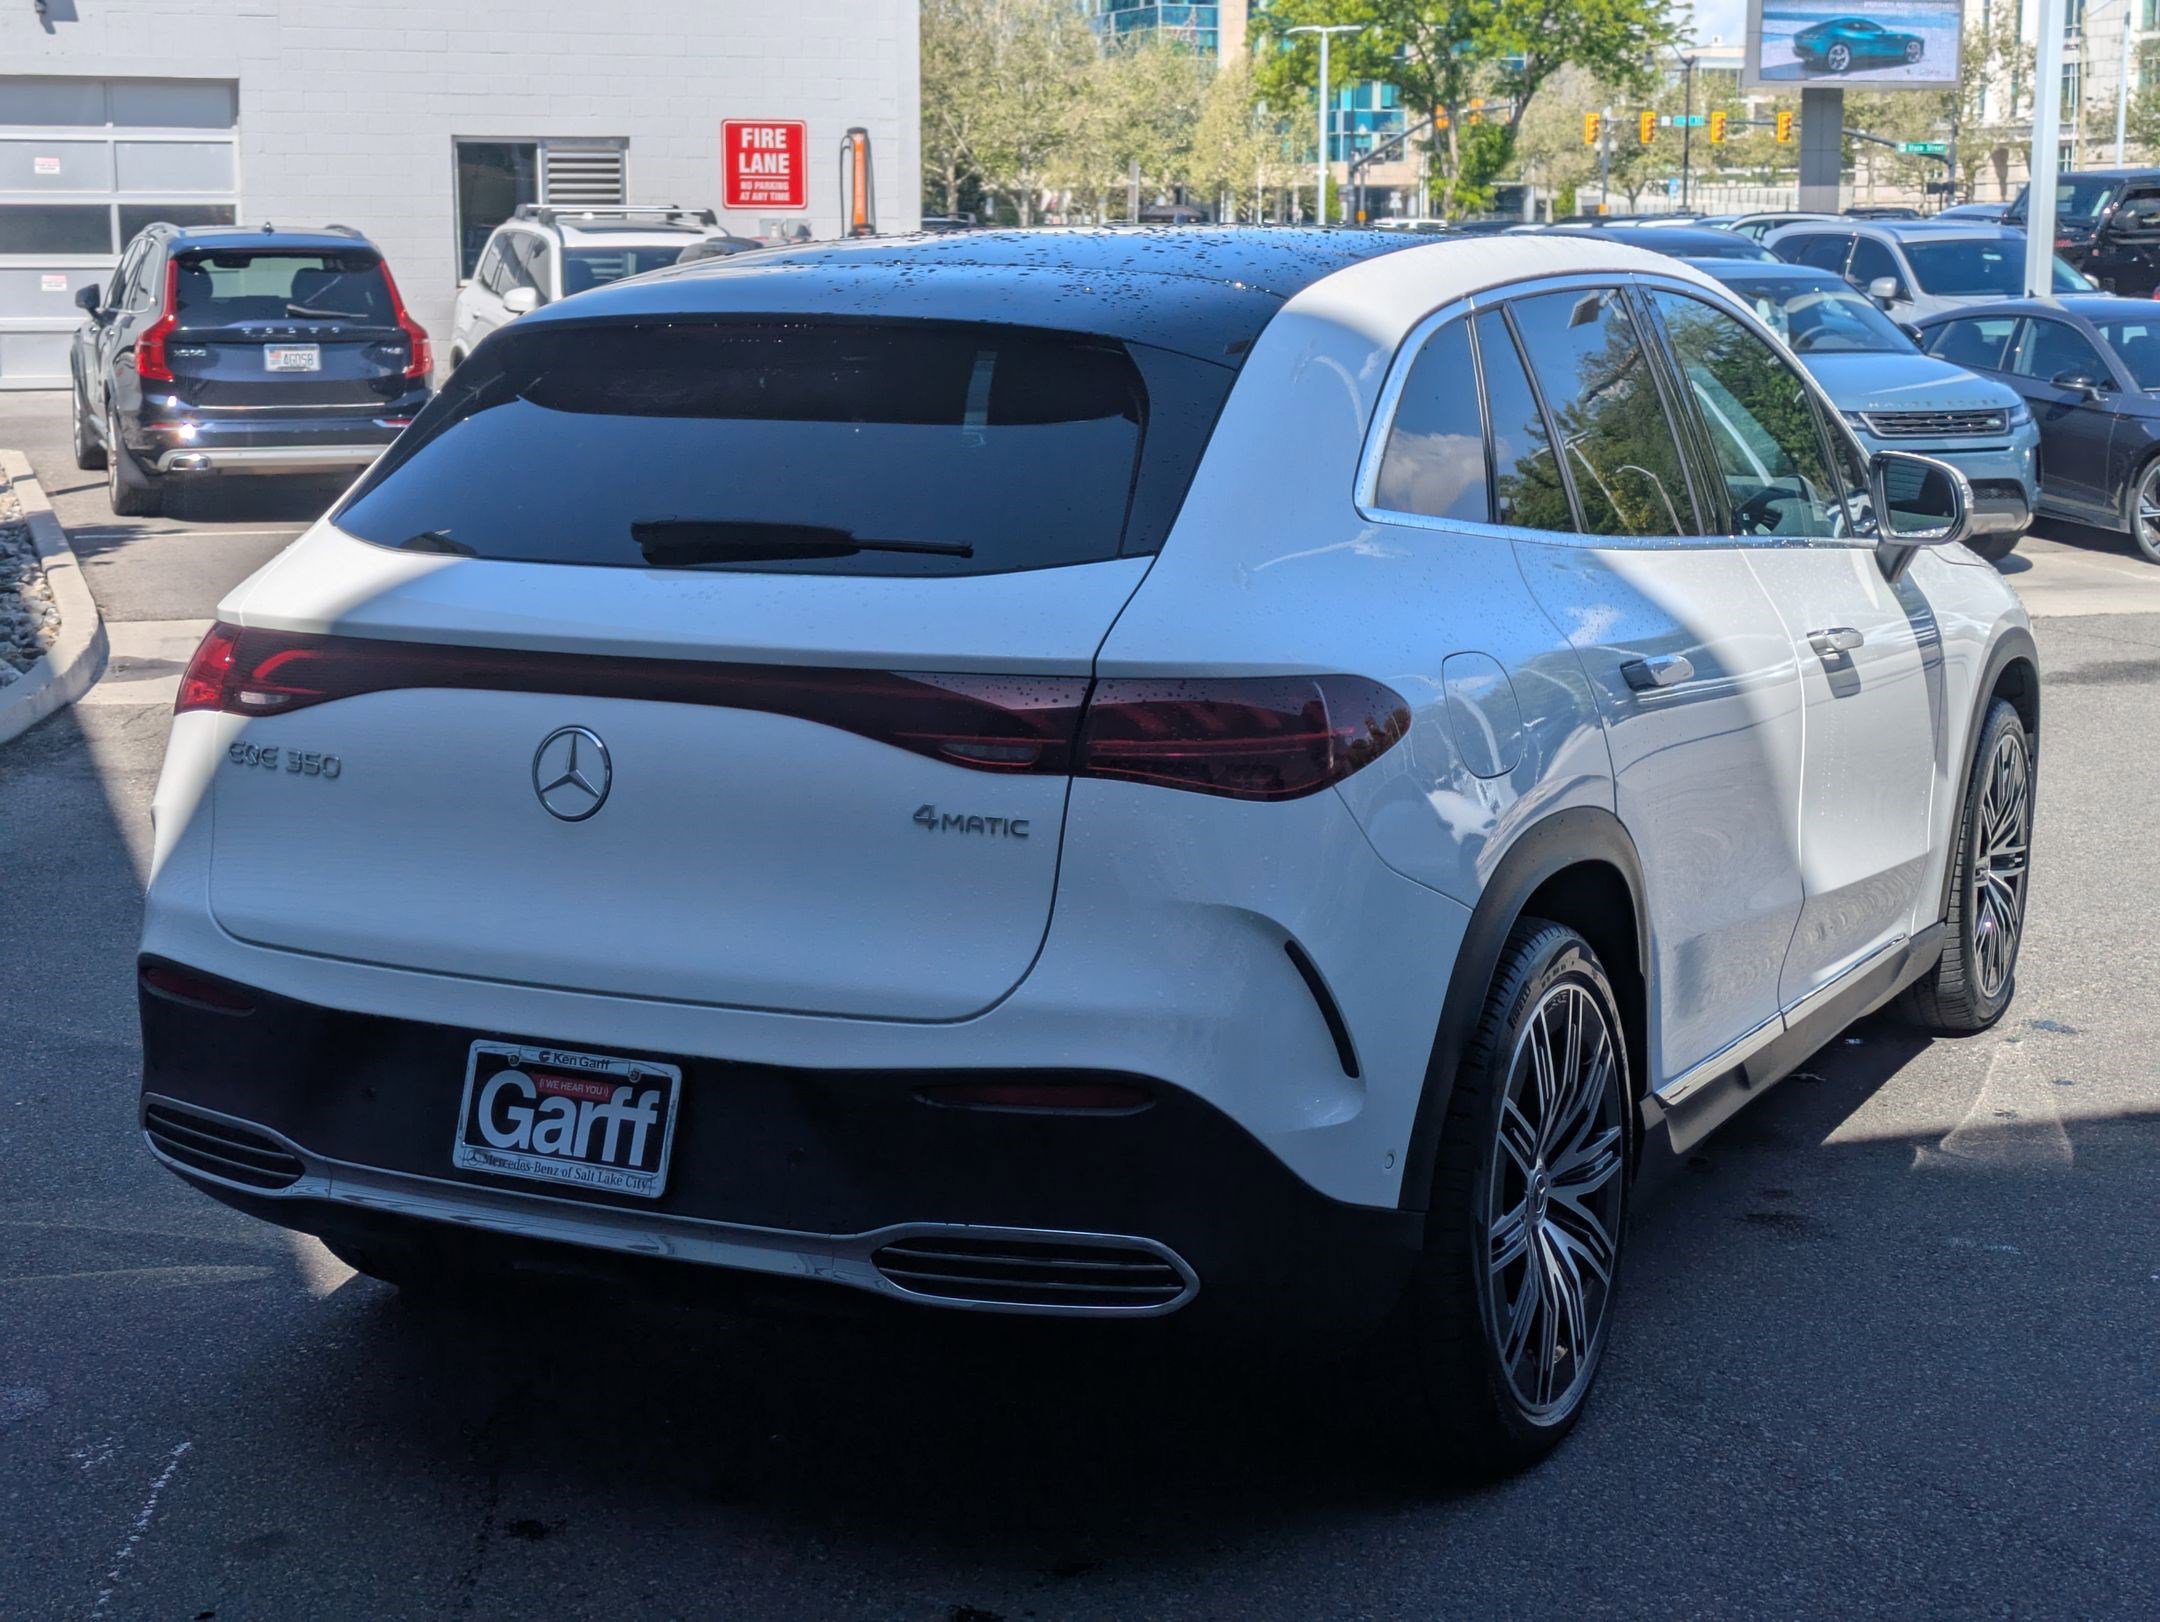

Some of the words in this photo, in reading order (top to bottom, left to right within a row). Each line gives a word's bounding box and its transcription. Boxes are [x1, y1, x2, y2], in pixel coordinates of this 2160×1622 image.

[741, 127, 787, 148] FIRE
[738, 152, 790, 174] LANE
[740, 181, 753, 190] NO
[754, 181, 789, 190] PARKING
[739, 192, 750, 201] AT
[752, 192, 768, 201] ANY
[769, 192, 790, 201] TIME
[229, 741, 279, 770] EQE
[286, 750, 342, 779] 350
[912, 803, 1030, 837] 4MATIC
[553, 1052, 577, 1066] Ken
[580, 1056, 610, 1070] Garff
[545, 1079, 560, 1089] WE
[561, 1081, 583, 1093] HEAR
[585, 1085, 603, 1095] YOU
[478, 1069, 661, 1167] Garff
[482, 1152, 559, 1176] Mercedes-Benz
[561, 1166, 574, 1178] of
[574, 1166, 595, 1182] Salt
[597, 1170, 623, 1187] Lake
[625, 1174, 648, 1192] City
